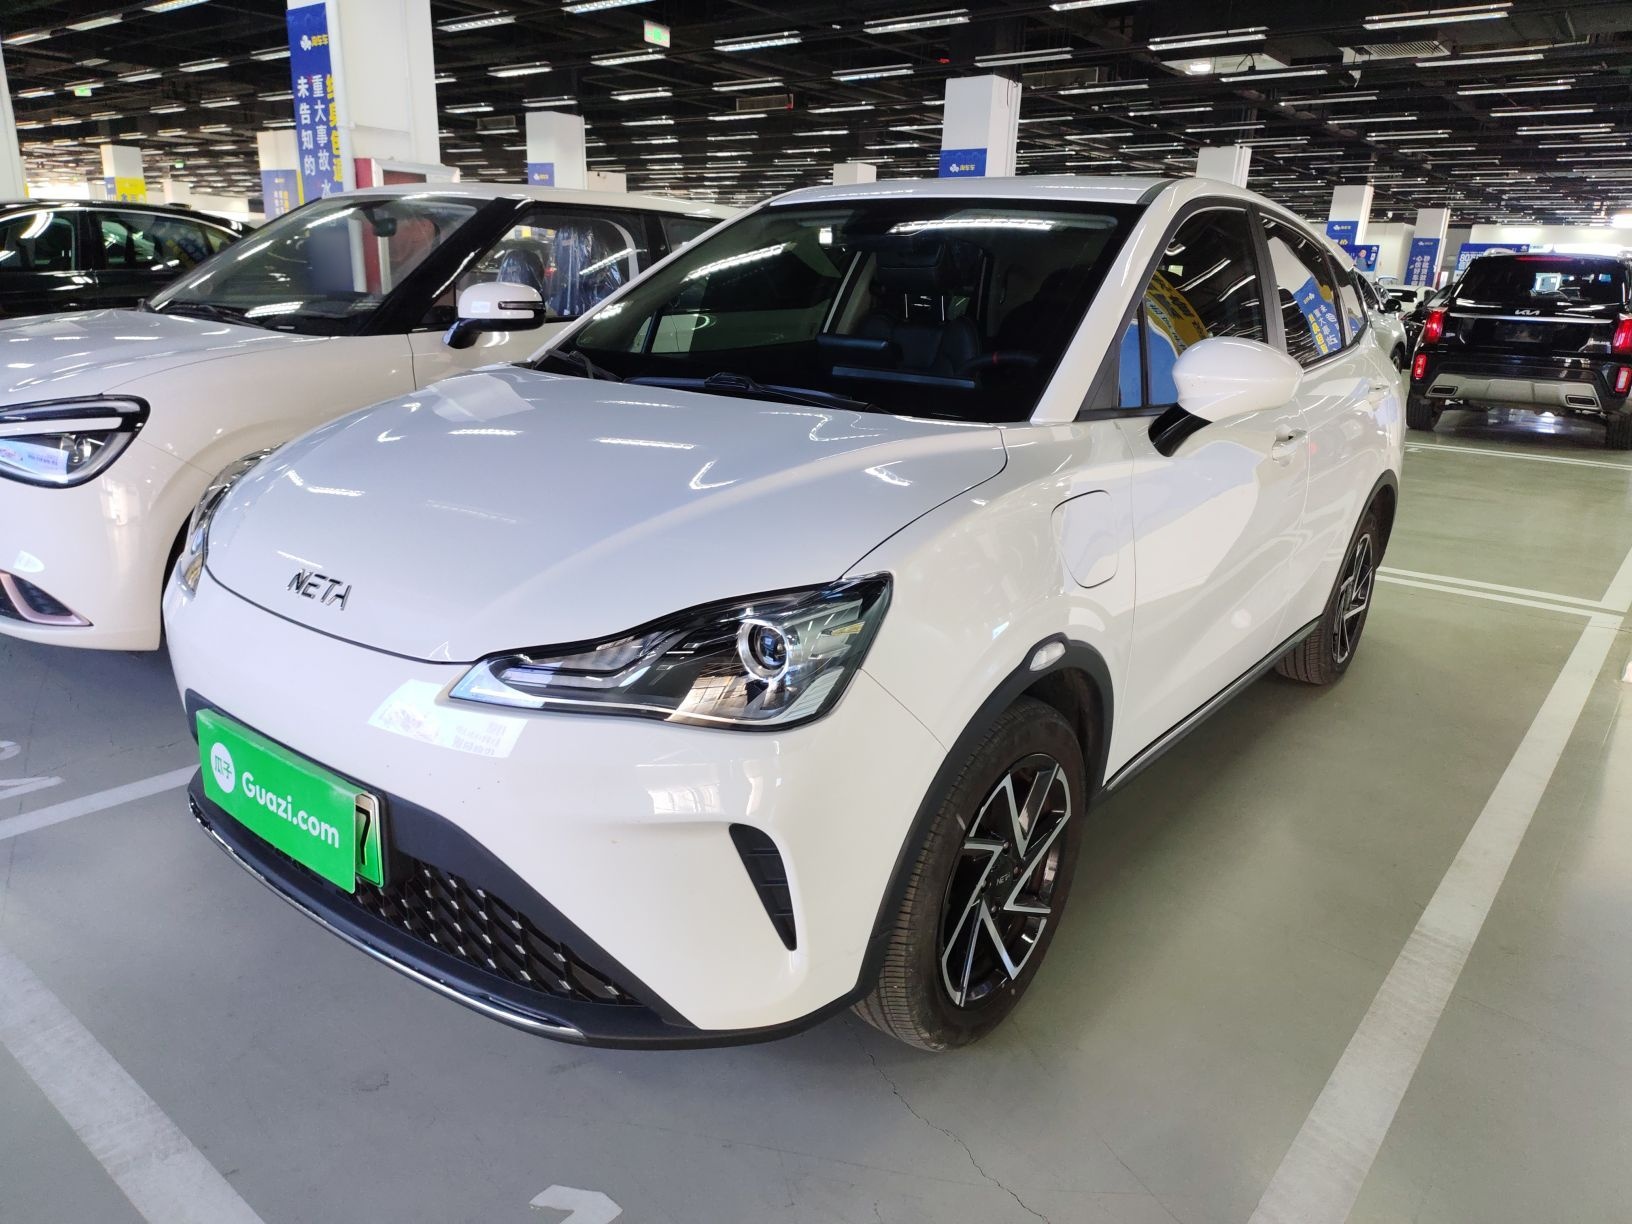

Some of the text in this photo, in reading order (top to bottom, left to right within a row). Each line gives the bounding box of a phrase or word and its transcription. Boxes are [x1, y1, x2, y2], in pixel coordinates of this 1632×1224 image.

[297, 75, 316, 176] 未告知的
[287, 569, 352, 611] NETA
[214, 754, 233, 780] 瓜子
[241, 771, 340, 849] Guazi.com
